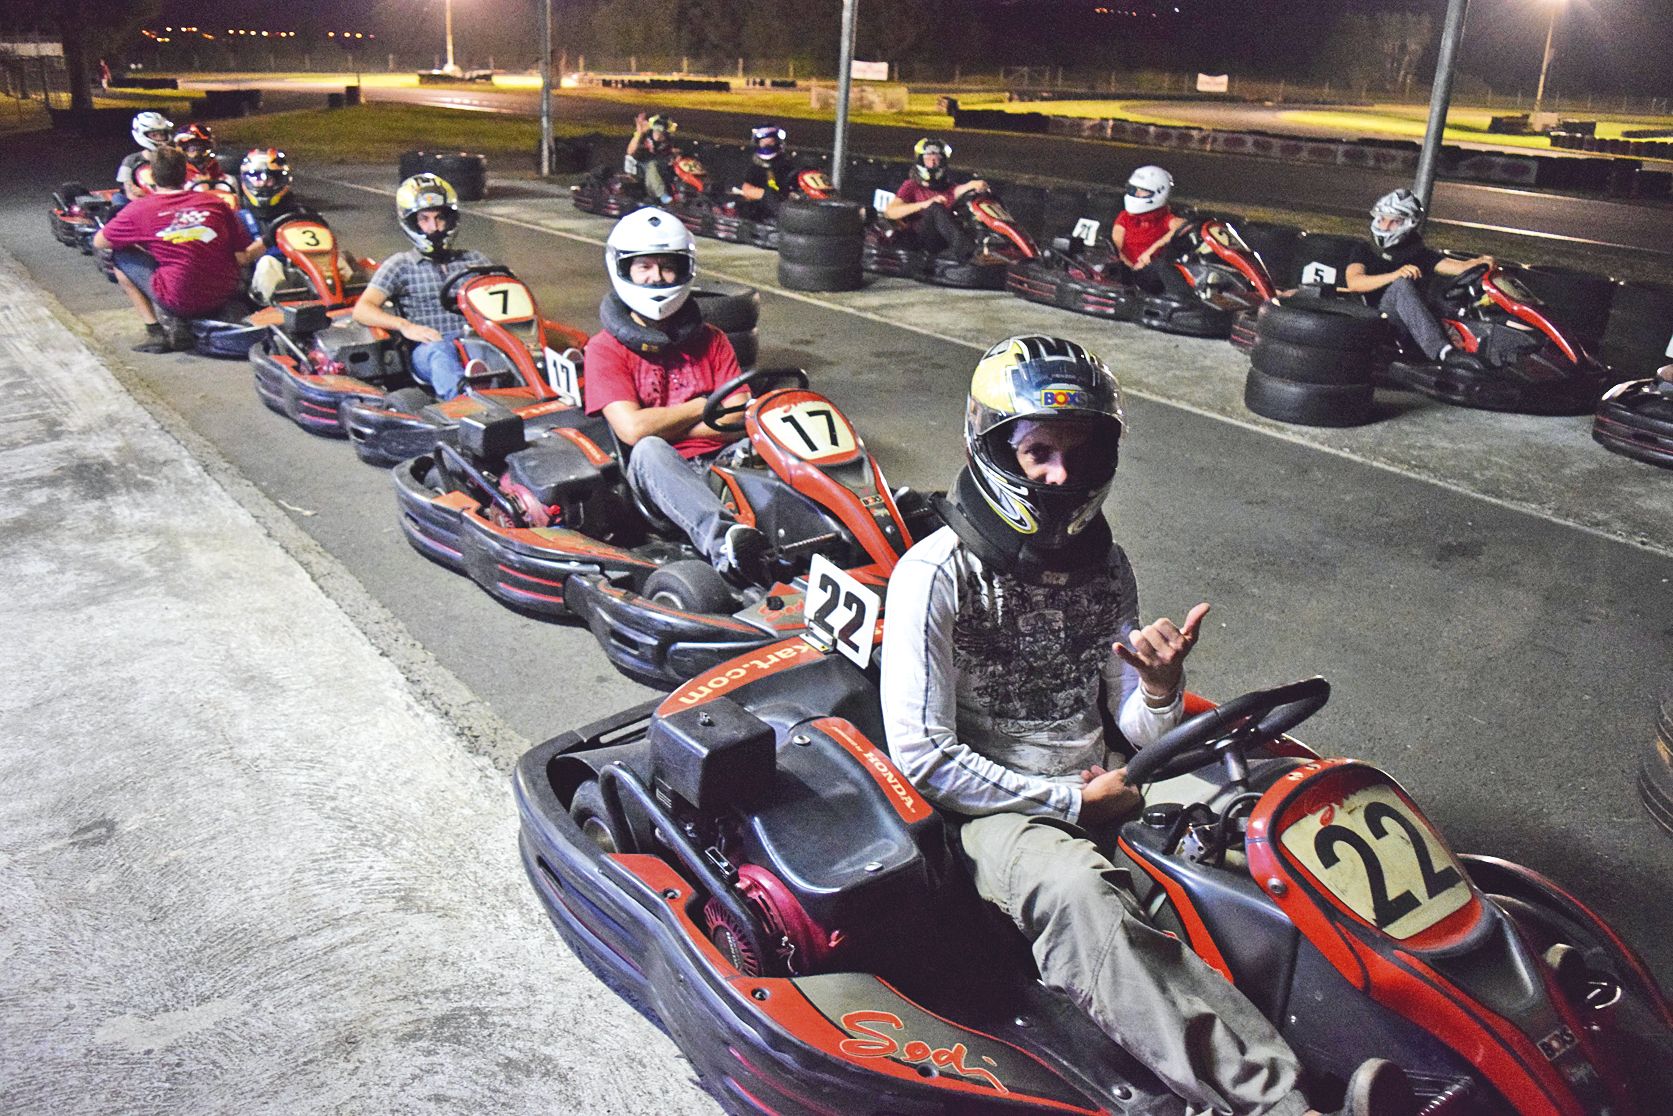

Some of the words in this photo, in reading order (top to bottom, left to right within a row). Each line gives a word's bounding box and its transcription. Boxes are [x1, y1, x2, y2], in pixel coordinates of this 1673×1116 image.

[302, 230, 320, 247] 3
[1313, 268, 1324, 283] 5
[488, 289, 509, 315] 7
[552, 359, 571, 393] 17
[780, 409, 839, 452] 17
[813, 573, 867, 654] 22
[863, 751, 916, 809] HONDA
[1313, 801, 1465, 930] 22
[839, 1009, 1010, 1095] Sodi
